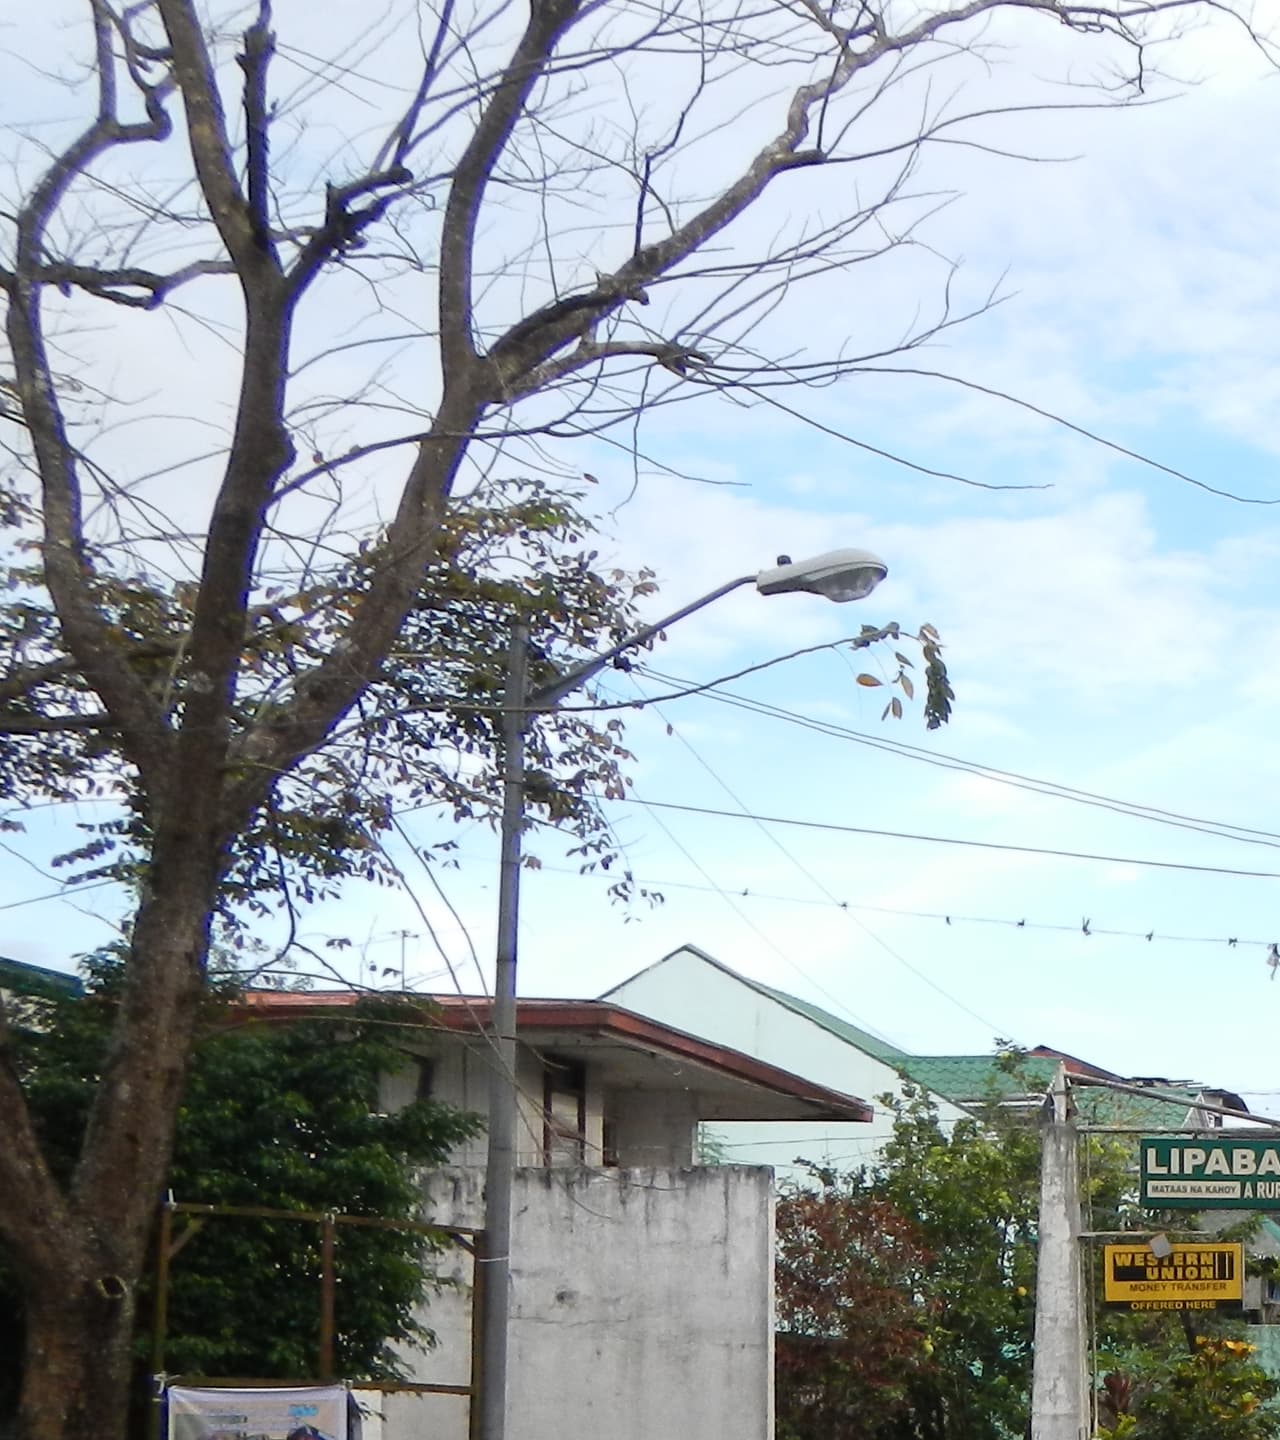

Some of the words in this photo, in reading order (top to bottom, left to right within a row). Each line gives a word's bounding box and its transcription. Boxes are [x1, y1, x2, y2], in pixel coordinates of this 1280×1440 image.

[1152, 1184, 1188, 1194] MATAAS
[1189, 1184, 1202, 1193] NA
[1205, 1183, 1238, 1194] KAHOY
[1244, 1182, 1254, 1199] A
[1146, 1266, 1214, 1280] UNION
[1129, 1283, 1167, 1292] MONEY
[1171, 1282, 1227, 1292] TRANSFER
[1130, 1301, 1184, 1311] OFFERED
[1186, 1300, 1217, 1310] HERE
